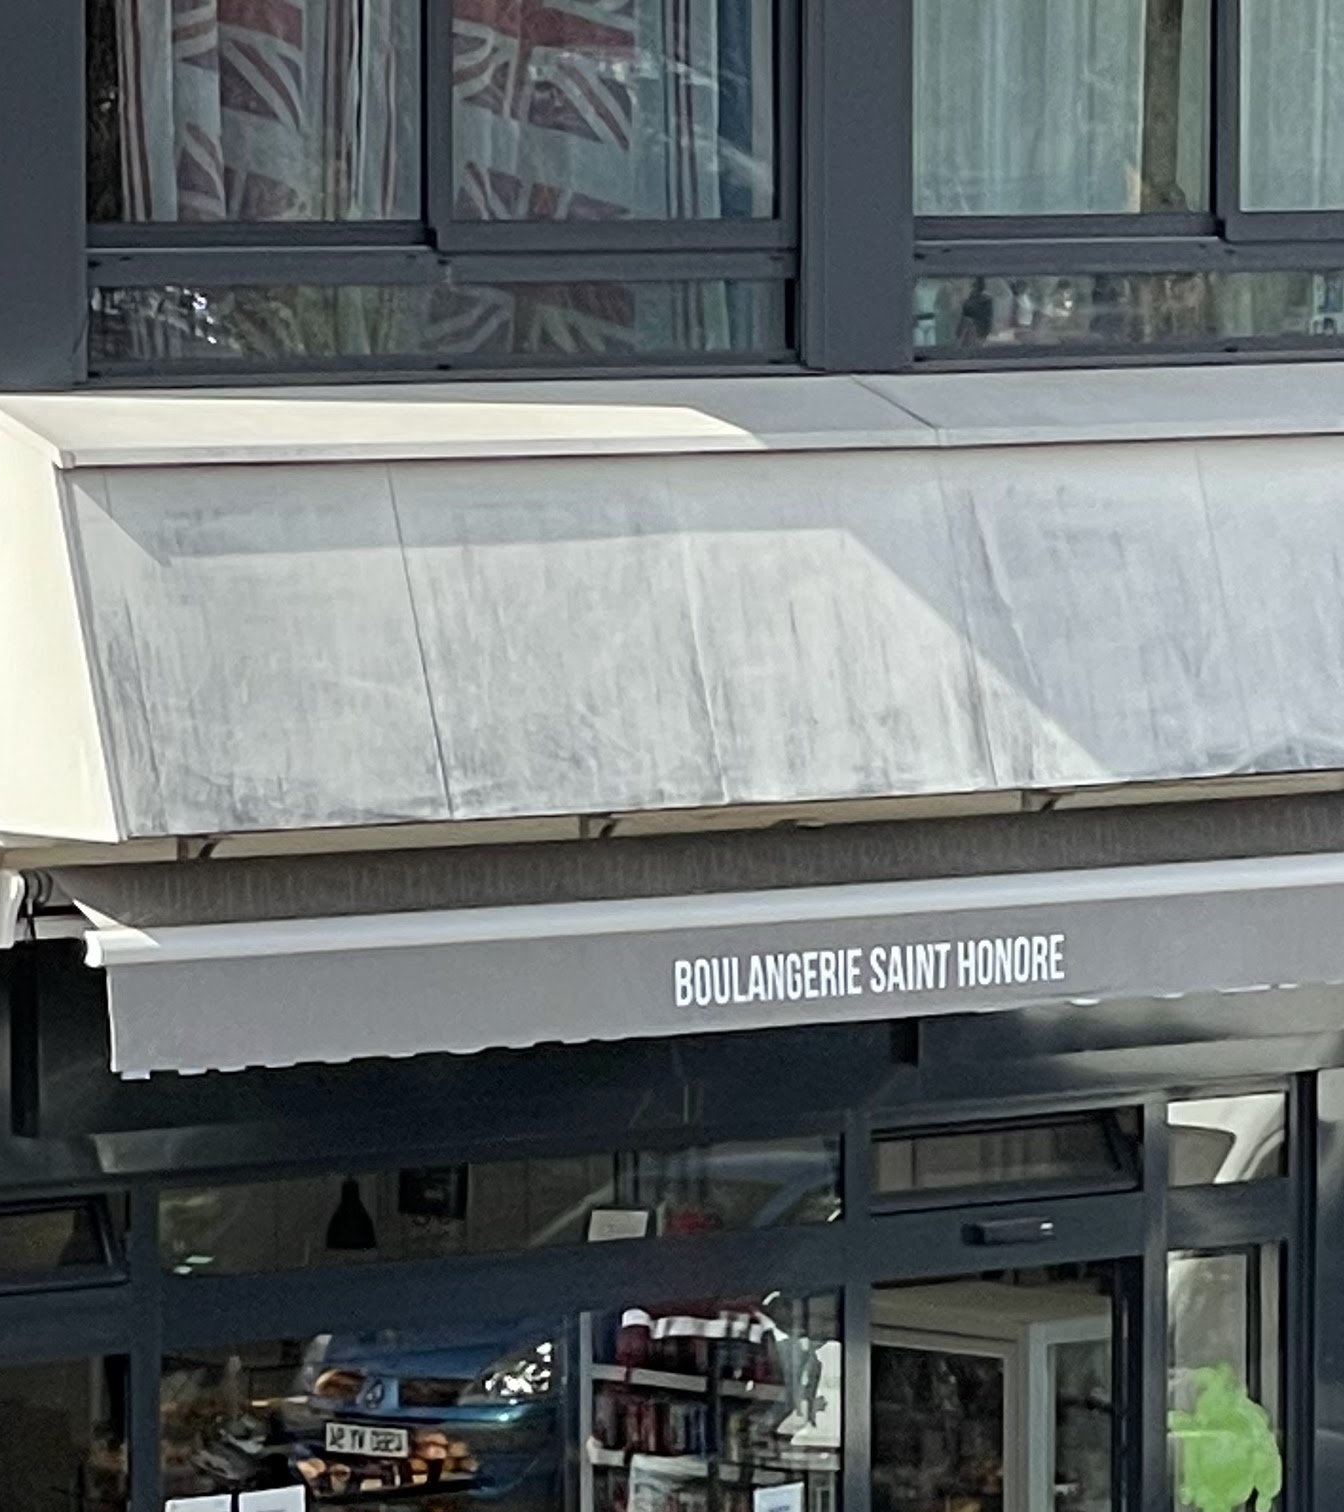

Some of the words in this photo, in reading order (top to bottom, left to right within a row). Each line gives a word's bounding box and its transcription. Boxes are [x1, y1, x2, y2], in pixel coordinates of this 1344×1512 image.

[674, 948, 863, 1007] BOULANGERIE
[869, 942, 952, 994] SAINT
[957, 933, 1066, 987] HONORE
